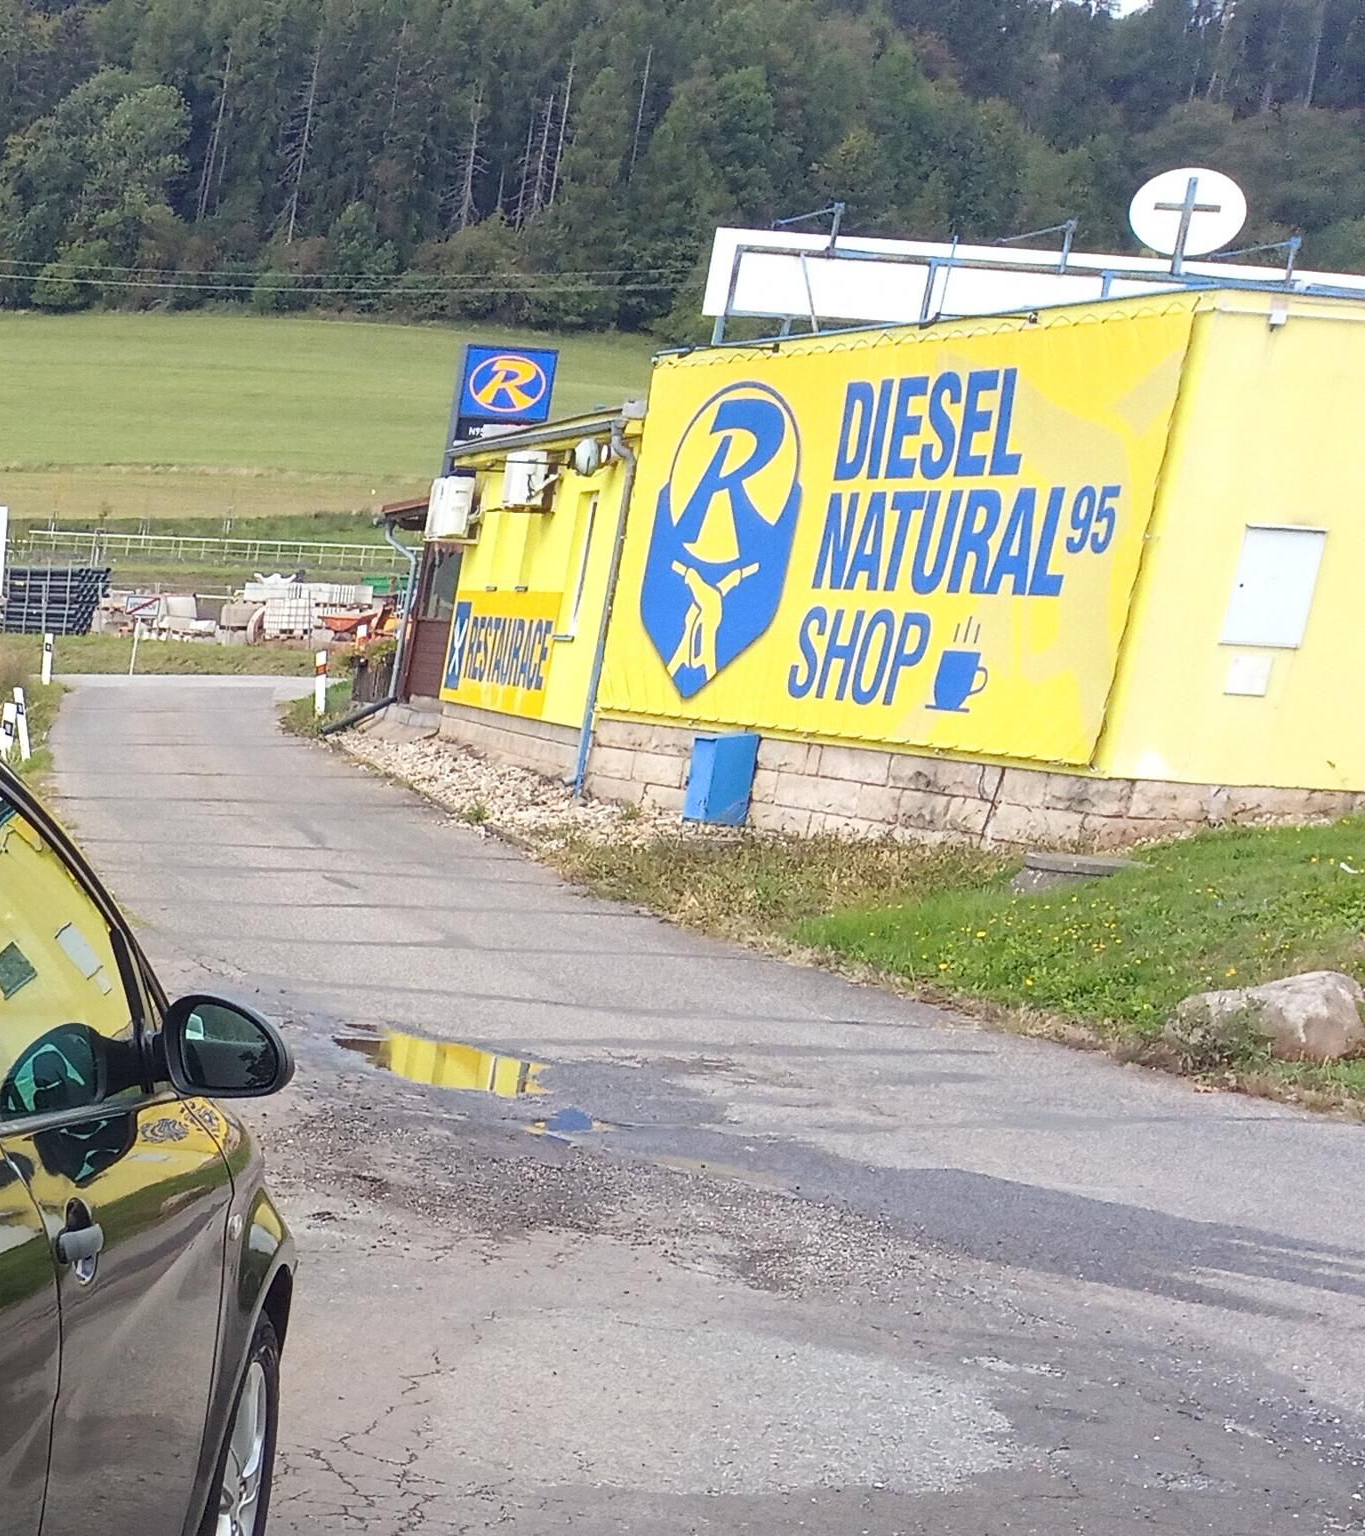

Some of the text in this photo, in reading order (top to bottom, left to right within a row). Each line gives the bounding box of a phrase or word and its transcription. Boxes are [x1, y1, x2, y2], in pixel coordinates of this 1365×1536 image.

[476, 359, 537, 408] R
[833, 368, 1022, 481] DIESEL
[811, 485, 1122, 597] NATURAL 95
[463, 616, 553, 690] RESTAURACE
[787, 606, 931, 706] SHOP
